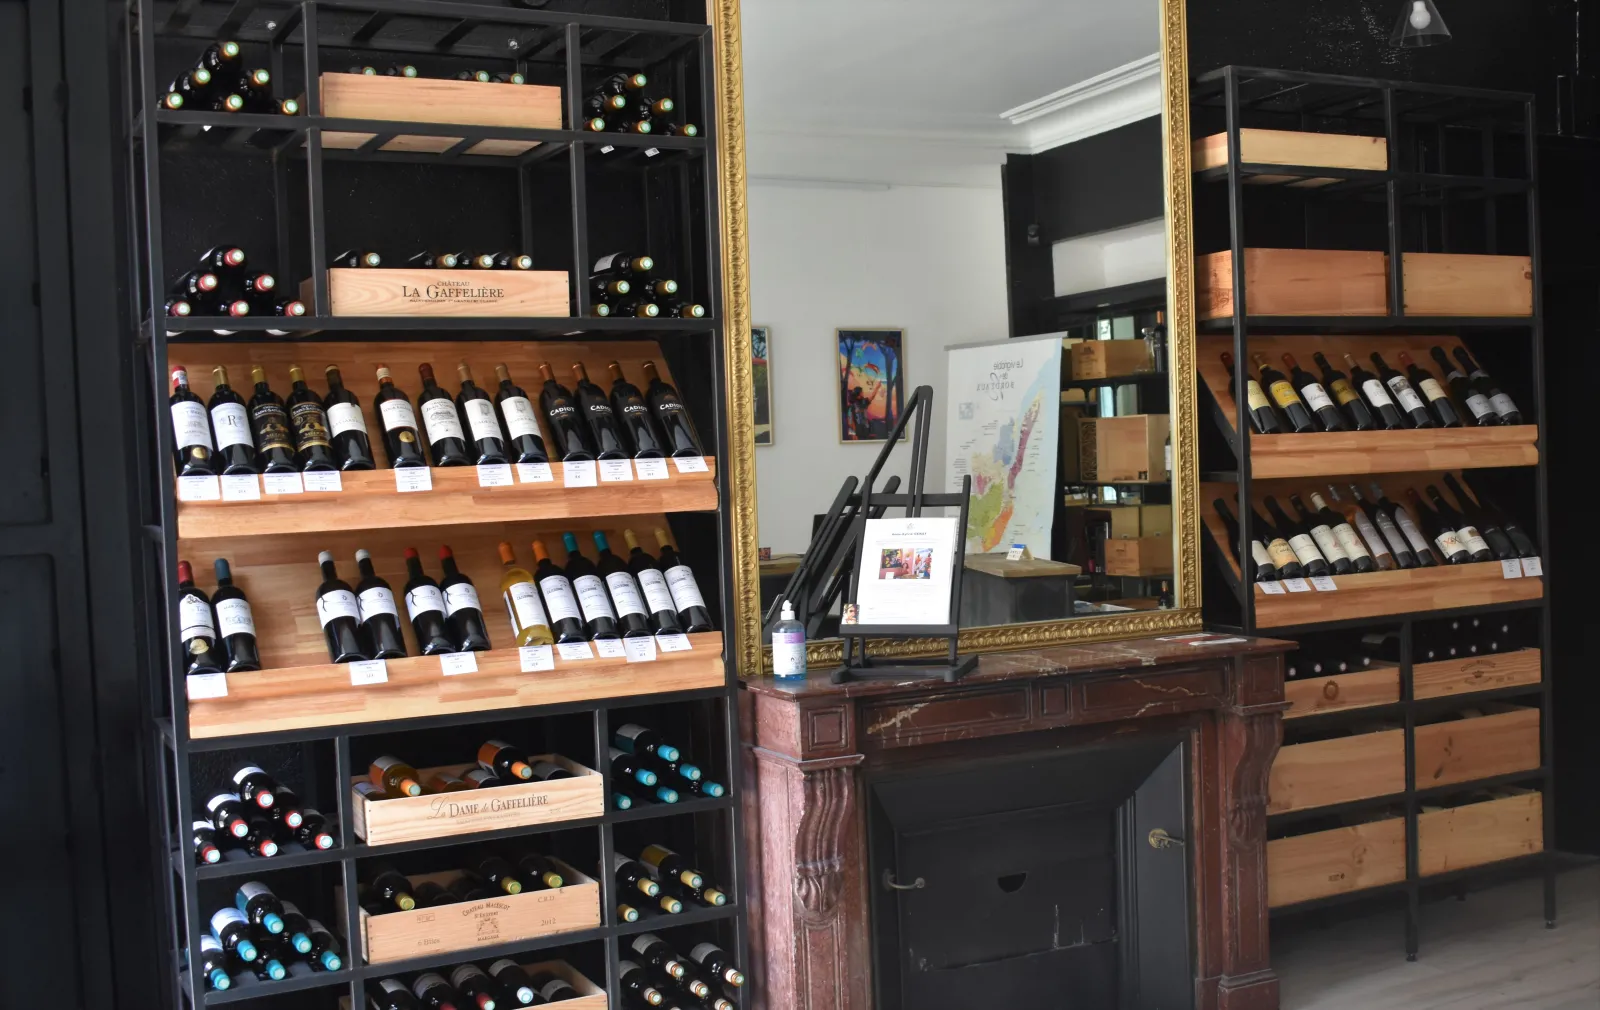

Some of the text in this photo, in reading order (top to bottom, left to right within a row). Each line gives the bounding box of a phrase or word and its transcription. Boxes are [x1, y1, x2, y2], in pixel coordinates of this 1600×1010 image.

[402, 284, 505, 299] LA GAFFELIÈRE
[549, 406, 575, 417] CADIOT
[227, 414, 238, 427] R
[449, 803, 479, 818] DAME
[491, 794, 549, 813] GAFFELIÈRE
[541, 917, 557, 927] 2012
